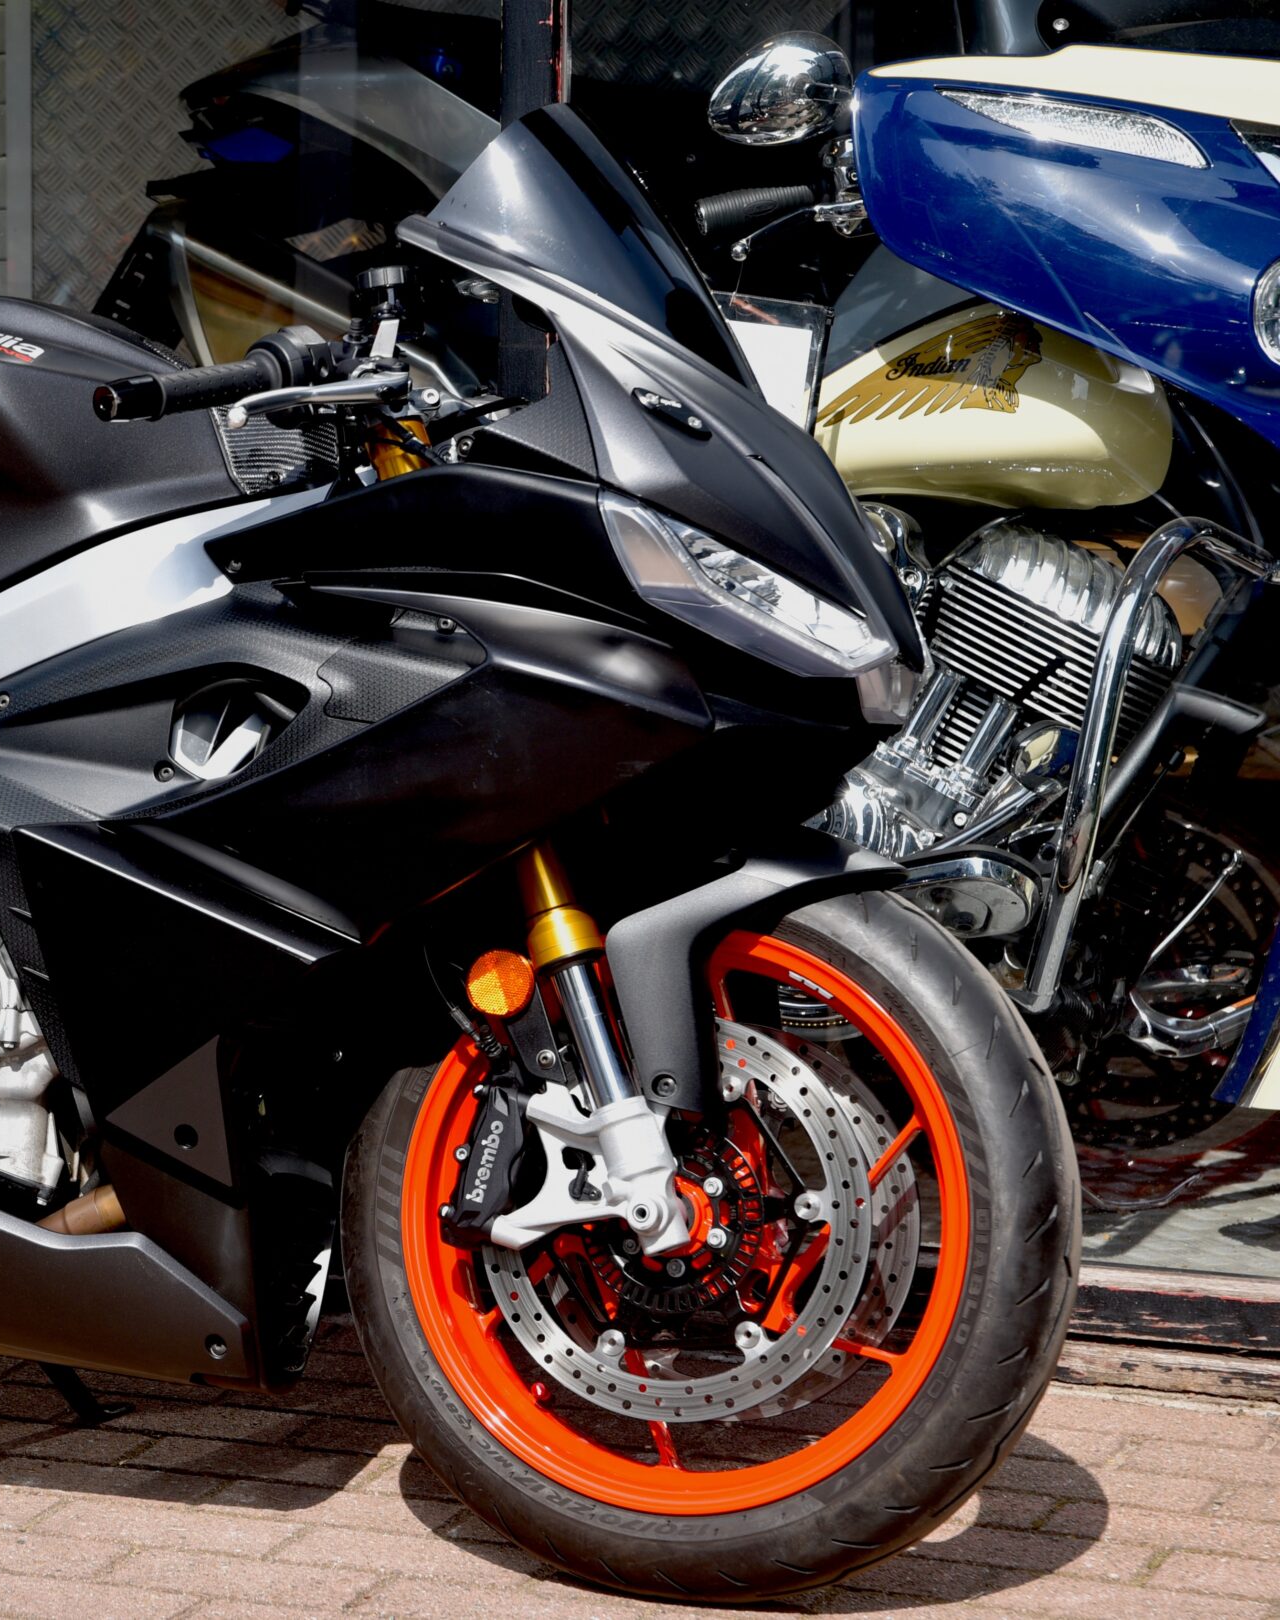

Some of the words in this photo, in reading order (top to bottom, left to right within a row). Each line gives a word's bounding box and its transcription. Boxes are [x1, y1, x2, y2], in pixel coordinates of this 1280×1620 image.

[885, 352, 972, 381] Indian
[465, 1119, 504, 1204] brembo
[954, 1207, 991, 1345] DIABLO
[883, 1356, 956, 1454] ROSSO
